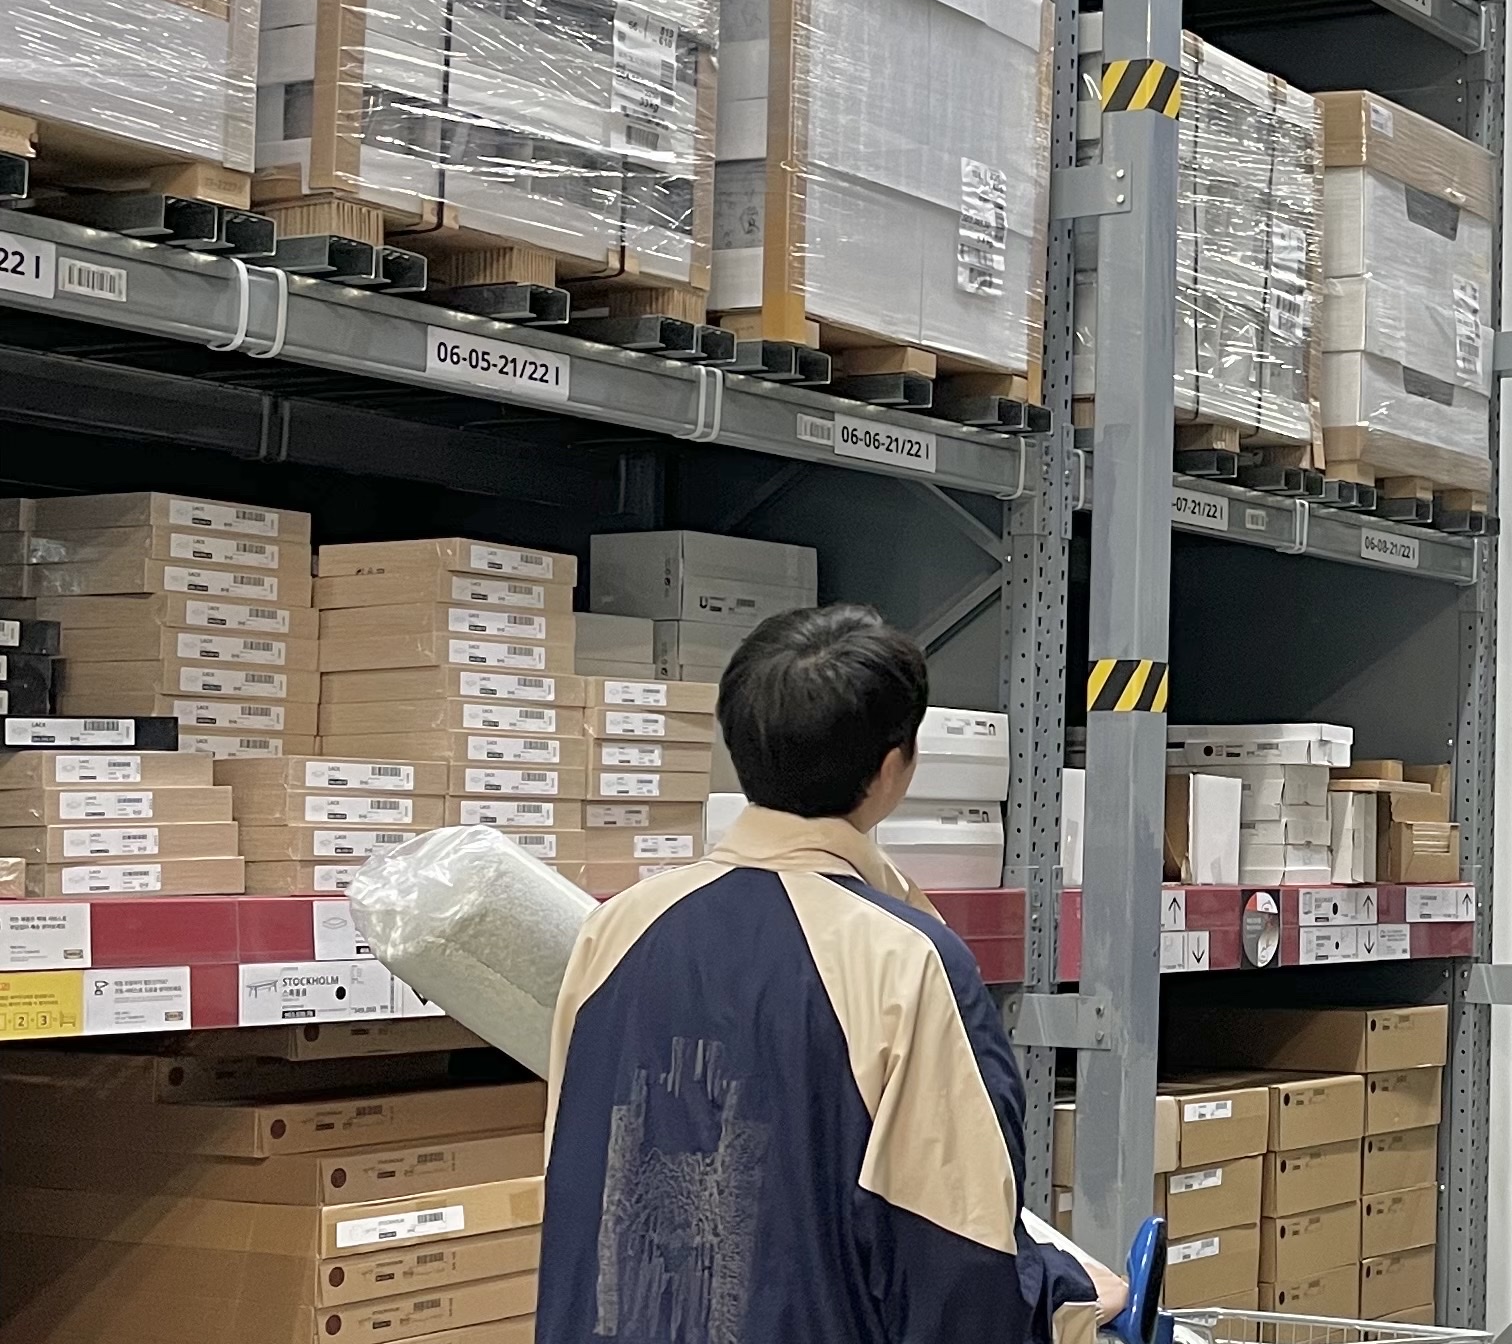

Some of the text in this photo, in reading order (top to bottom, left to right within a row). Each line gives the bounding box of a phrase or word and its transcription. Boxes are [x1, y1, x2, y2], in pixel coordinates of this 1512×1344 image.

[437, 341, 549, 384] 06-05-21/22
[841, 425, 922, 458] 06-06-21/22
[282, 976, 339, 987] STOCKHOLM
[18, 1015, 47, 1027] 2 3
